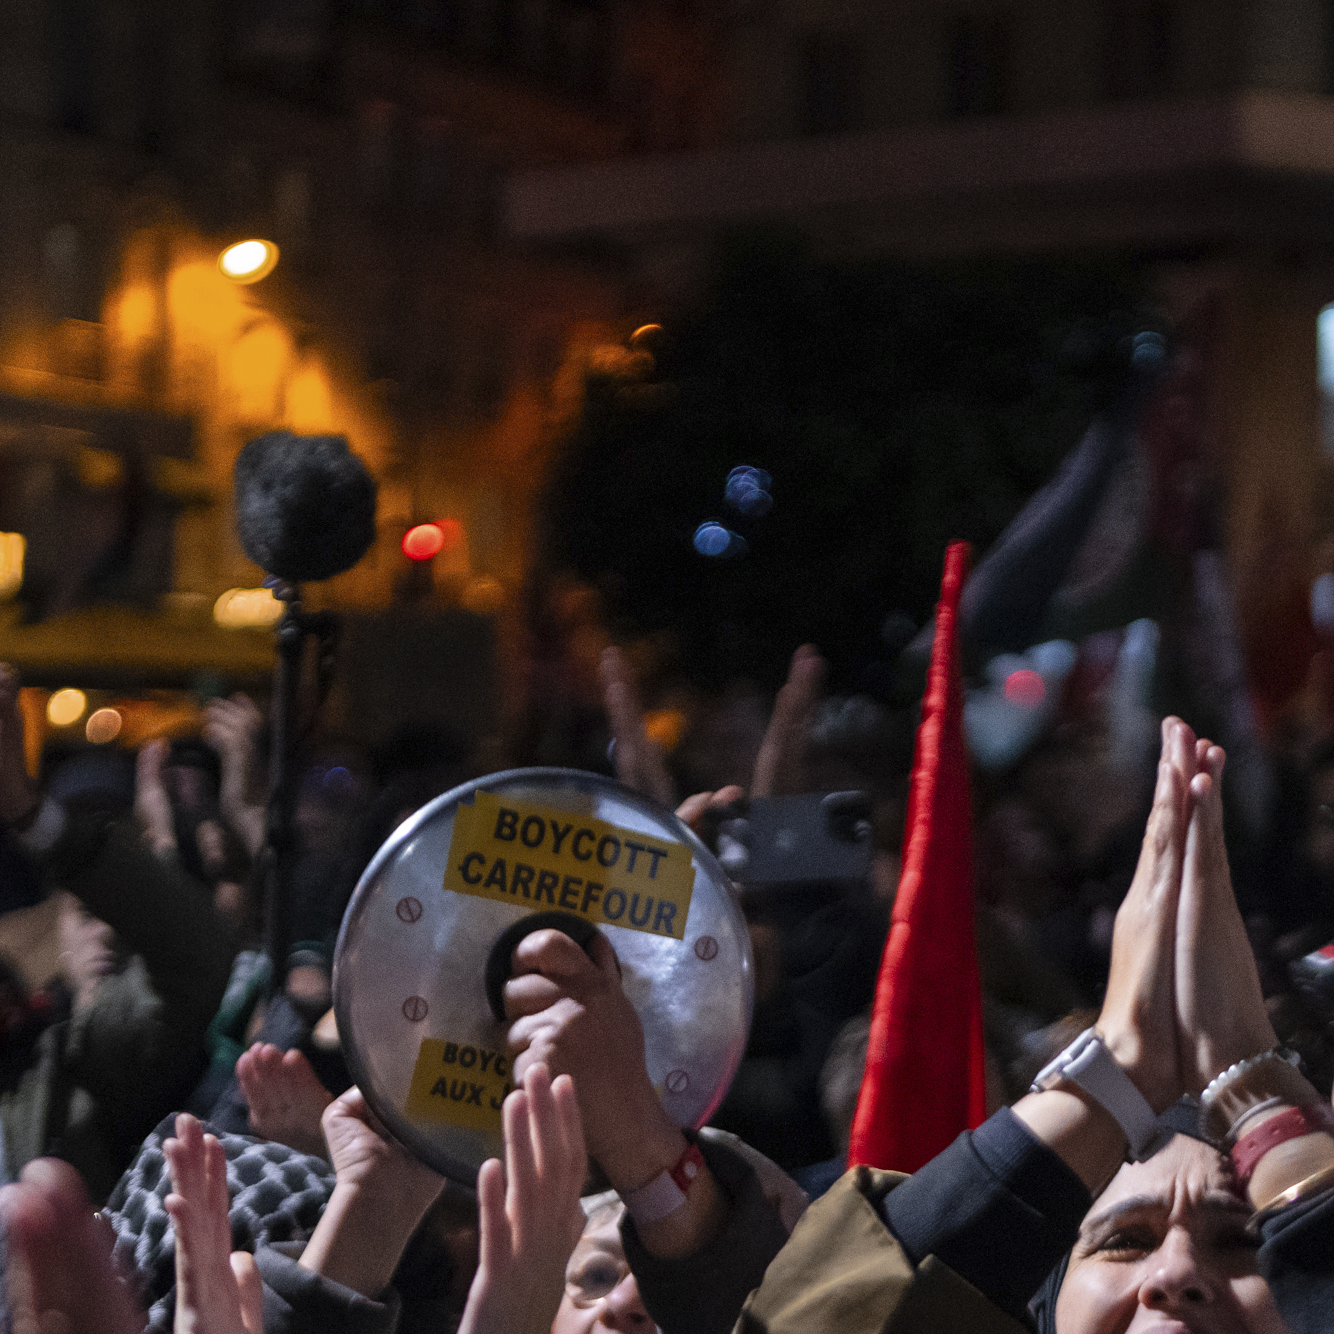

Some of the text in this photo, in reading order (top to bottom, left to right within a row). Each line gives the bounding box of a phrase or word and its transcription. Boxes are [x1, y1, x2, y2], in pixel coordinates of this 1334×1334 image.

[494, 808, 667, 878] BOYCOTT
[459, 852, 677, 934] CARREFOUR
[443, 1042, 507, 1076] BOYC
[431, 1077, 484, 1107] AUX
